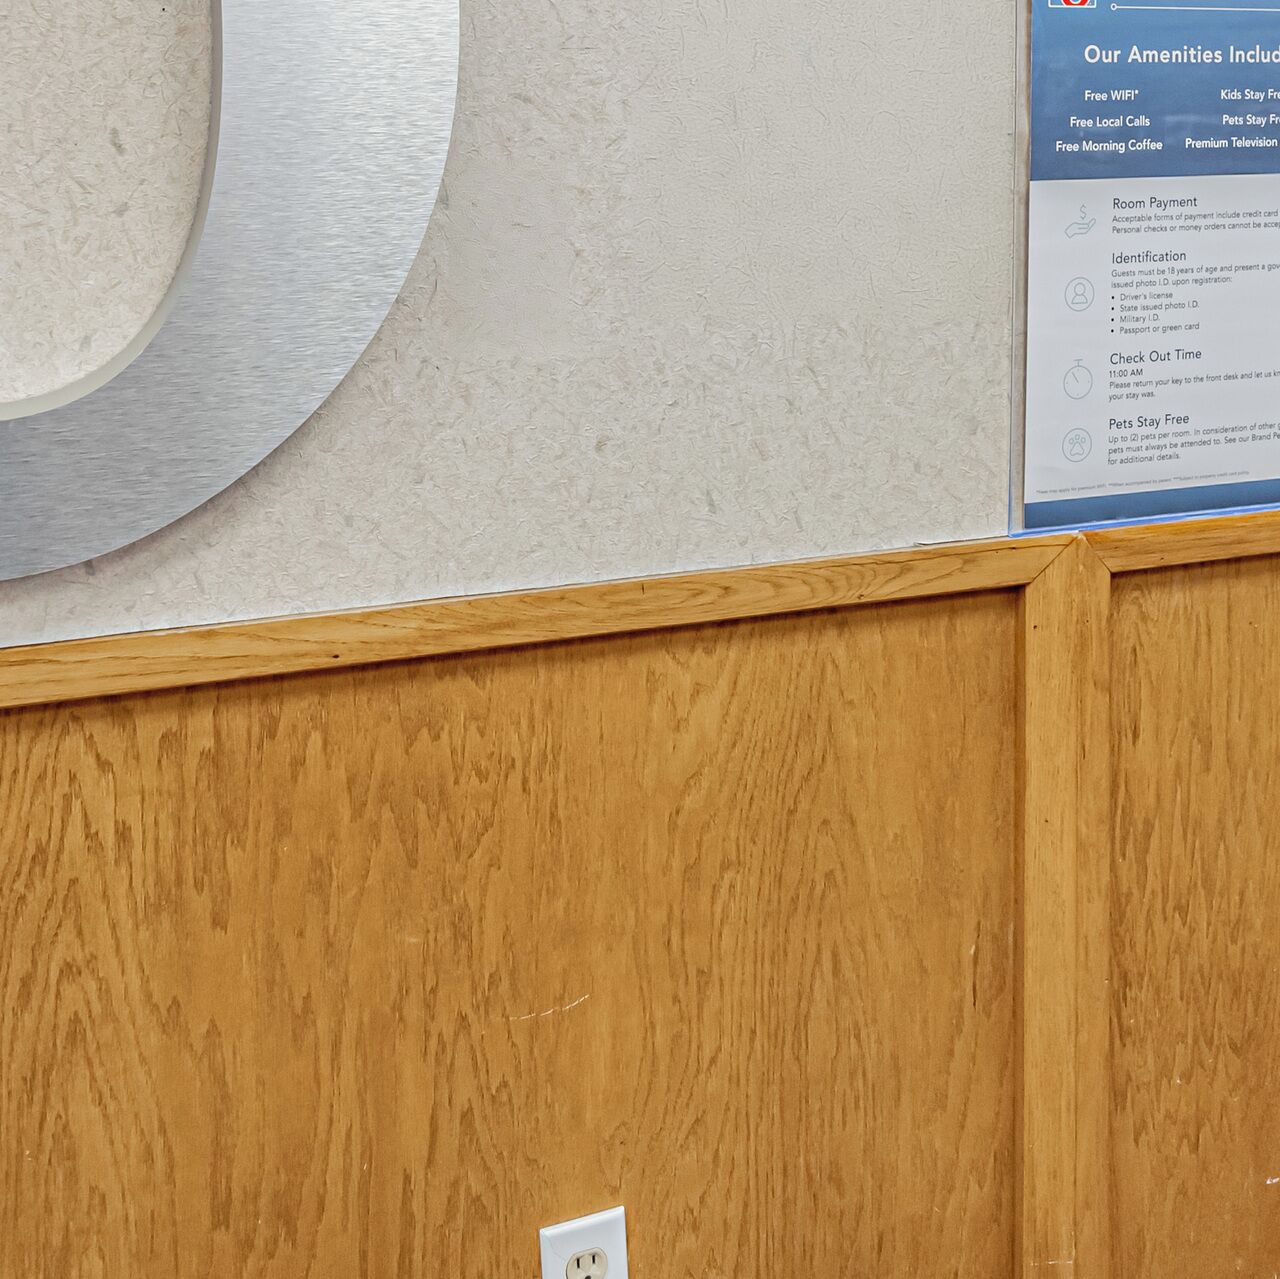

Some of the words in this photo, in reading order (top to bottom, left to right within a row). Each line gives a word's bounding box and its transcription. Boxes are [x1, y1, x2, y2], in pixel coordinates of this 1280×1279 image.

[1084, 44, 1121, 63] Our
[1127, 45, 1223, 63] Amenities
[1084, 90, 1108, 101] Free
[1220, 89, 1242, 100] Kids
[1244, 89, 1265, 102] Stay
[1070, 116, 1093, 128] Free
[1096, 115, 1123, 127] Local
[1126, 115, 1150, 127] Calls
[1222, 114, 1243, 125] Pets
[1246, 114, 1267, 127] Stay
[1055, 141, 1079, 152] Free
[1082, 140, 1125, 153] Morning
[1128, 139, 1163, 150] Coffee
[1185, 137, 1228, 149] Premium
[1230, 136, 1278, 148] Television
[1113, 198, 1145, 210] Room
[1149, 196, 1198, 211] Payment
[1112, 214, 1152, 223] Acceptable
[1154, 213, 1174, 221] forms
[1175, 212, 1183, 221] of
[1184, 212, 1214, 222] payment
[1216, 210, 1240, 219] include
[1242, 209, 1262, 218] credit
[1263, 208, 1278, 217] card
[1112, 225, 1142, 234] Personal
[1143, 224, 1168, 233] checks
[1179, 224, 1202, 232] money
[1204, 222, 1226, 230] orders
[1228, 222, 1251, 230] cannot
[1252, 221, 1261, 229] be
[1112, 250, 1187, 264] Identification
[1111, 269, 1136, 278] Guests
[1156, 267, 1166, 275] be
[1176, 267, 1194, 276] years
[1196, 265, 1204, 273] of
[1205, 266, 1218, 275] age
[1220, 264, 1233, 272] and
[1234, 263, 1260, 273] present
[1111, 280, 1134, 288] issued
[1136, 279, 1157, 289] photo
[1172, 278, 1190, 287] upon
[1149, 292, 1173, 300] license
[1120, 304, 1138, 312] State
[1140, 302, 1163, 311] issued
[1164, 301, 1186, 311] photo
[1120, 315, 1146, 324] Military
[1120, 326, 1150, 335] Passport
[1161, 324, 1183, 333] green
[1184, 322, 1200, 331] card
[1110, 351, 1145, 365] Check
[1149, 350, 1171, 362] Out
[1174, 348, 1202, 360] Time
[1109, 369, 1128, 378] 11:00
[1130, 368, 1143, 377] AM
[1109, 381, 1131, 389] Please
[1133, 379, 1154, 388] return
[1155, 379, 1169, 388] your
[1171, 377, 1183, 386] key
[1184, 376, 1191, 384] to
[1193, 375, 1204, 383] the
[1206, 374, 1222, 382] front
[1223, 372, 1238, 381] desk
[1240, 371, 1253, 380] and
[1254, 371, 1263, 379] let
[1109, 393, 1124, 403] your
[1125, 392, 1139, 401] stay
[1109, 418, 1133, 430] Pets
[1137, 416, 1161, 430] Stay
[1165, 414, 1190, 425] Free
[1108, 436, 1118, 445] Up
[1140, 434, 1156, 442] pets
[1158, 432, 1170, 440] per
[1194, 428, 1201, 436] In
[1202, 424, 1247, 435] consideration
[1249, 423, 1257, 431] of
[1258, 422, 1275, 430] other
[1108, 446, 1124, 455] pets
[1126, 445, 1143, 453] must
[1145, 443, 1167, 452] always
[1169, 441, 1178, 449] be
[1180, 439, 1211, 448] attended
[1224, 436, 1237, 444] See
[1251, 433, 1271, 441] Brand
[1108, 457, 1117, 465] for
[1119, 454, 1154, 464] additional
